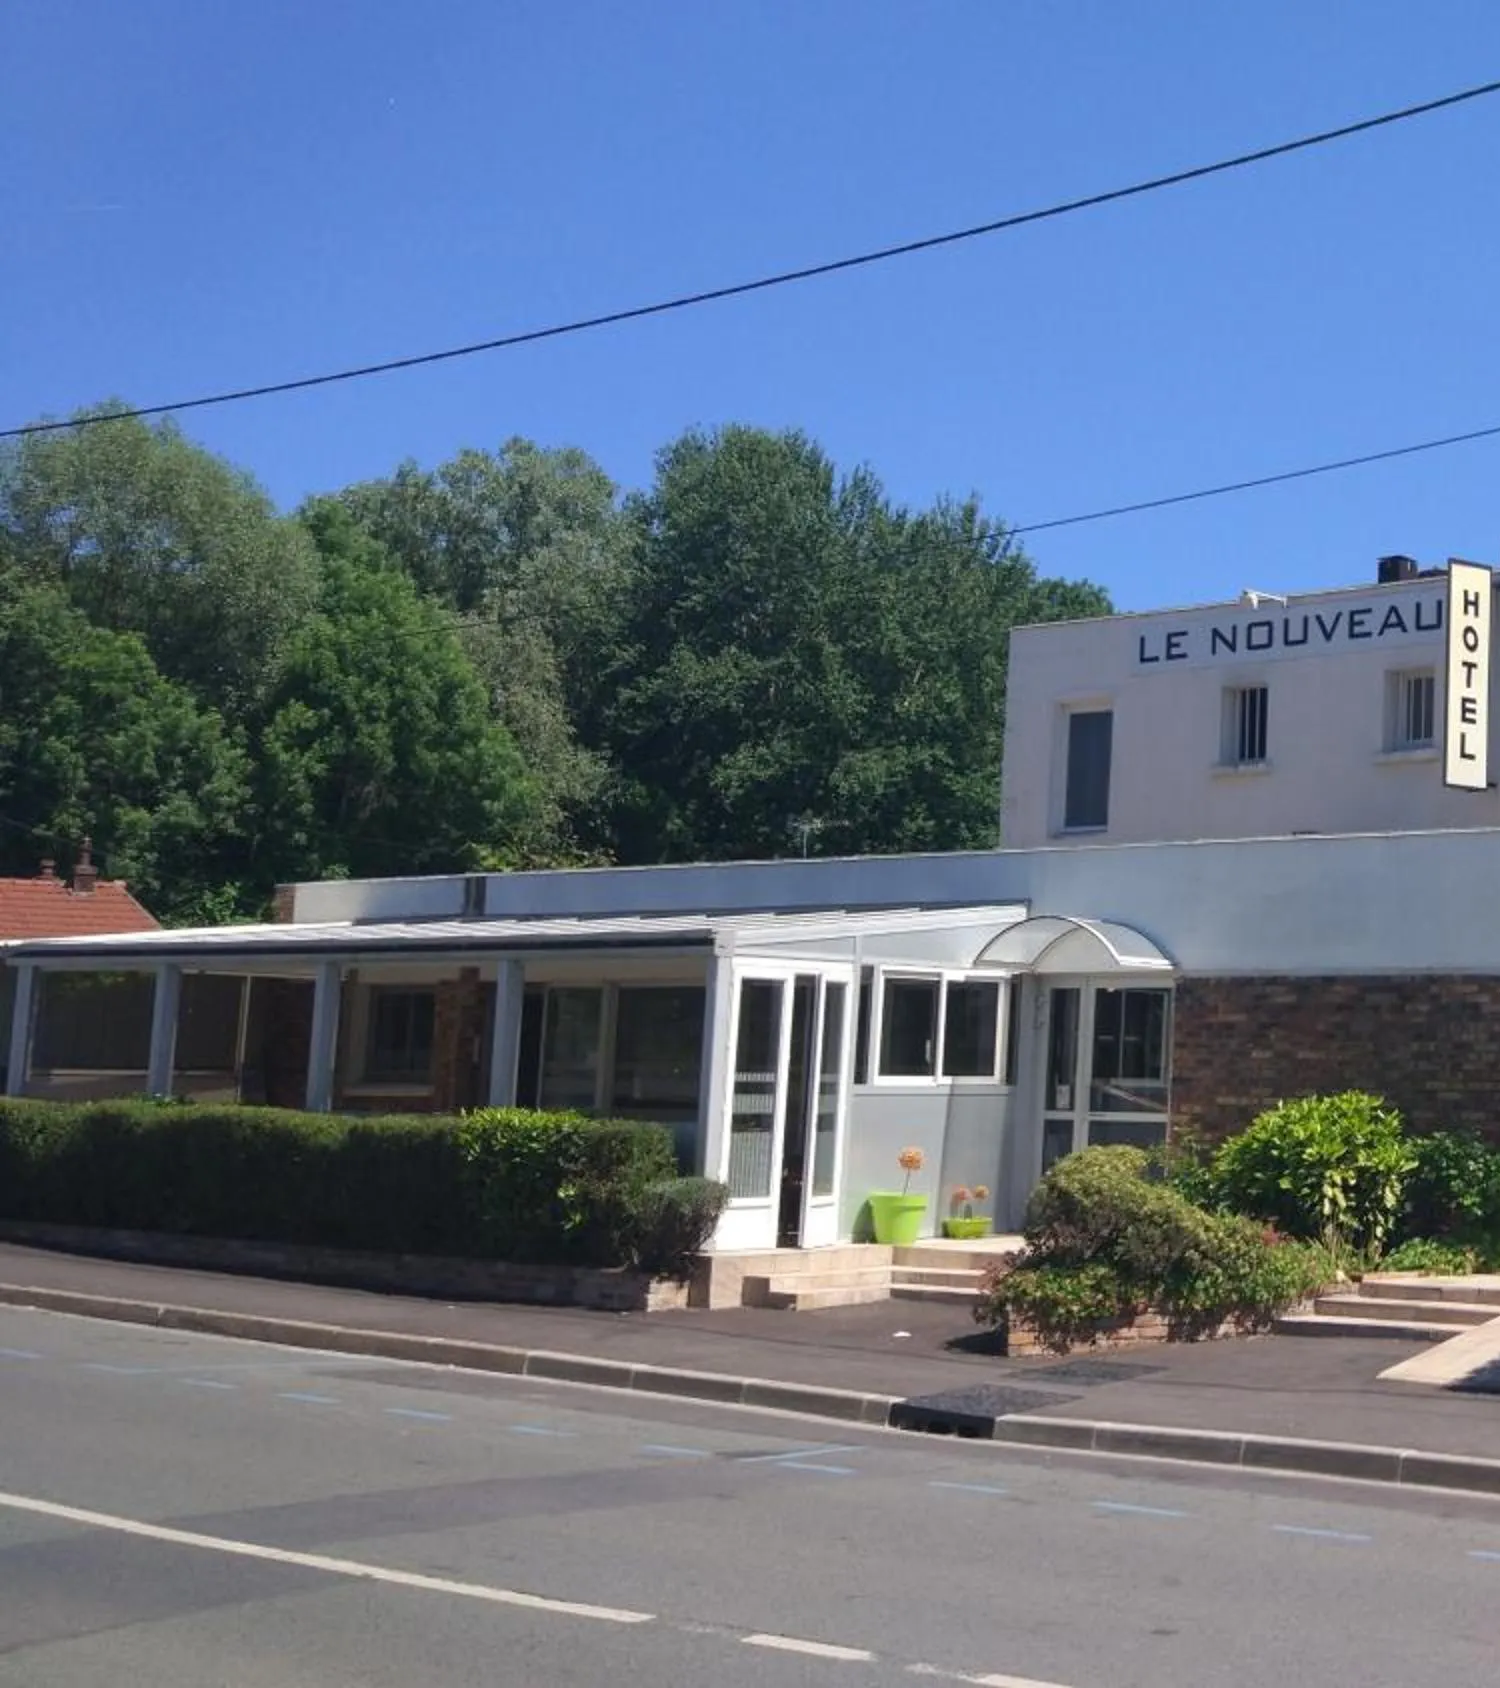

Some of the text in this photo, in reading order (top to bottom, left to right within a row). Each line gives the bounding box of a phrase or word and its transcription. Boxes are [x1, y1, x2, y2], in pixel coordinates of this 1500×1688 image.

[1139, 630, 1189, 664] LE
[1211, 599, 1443, 656] NOUVEAU
[1459, 589, 1480, 760] HOTEL
